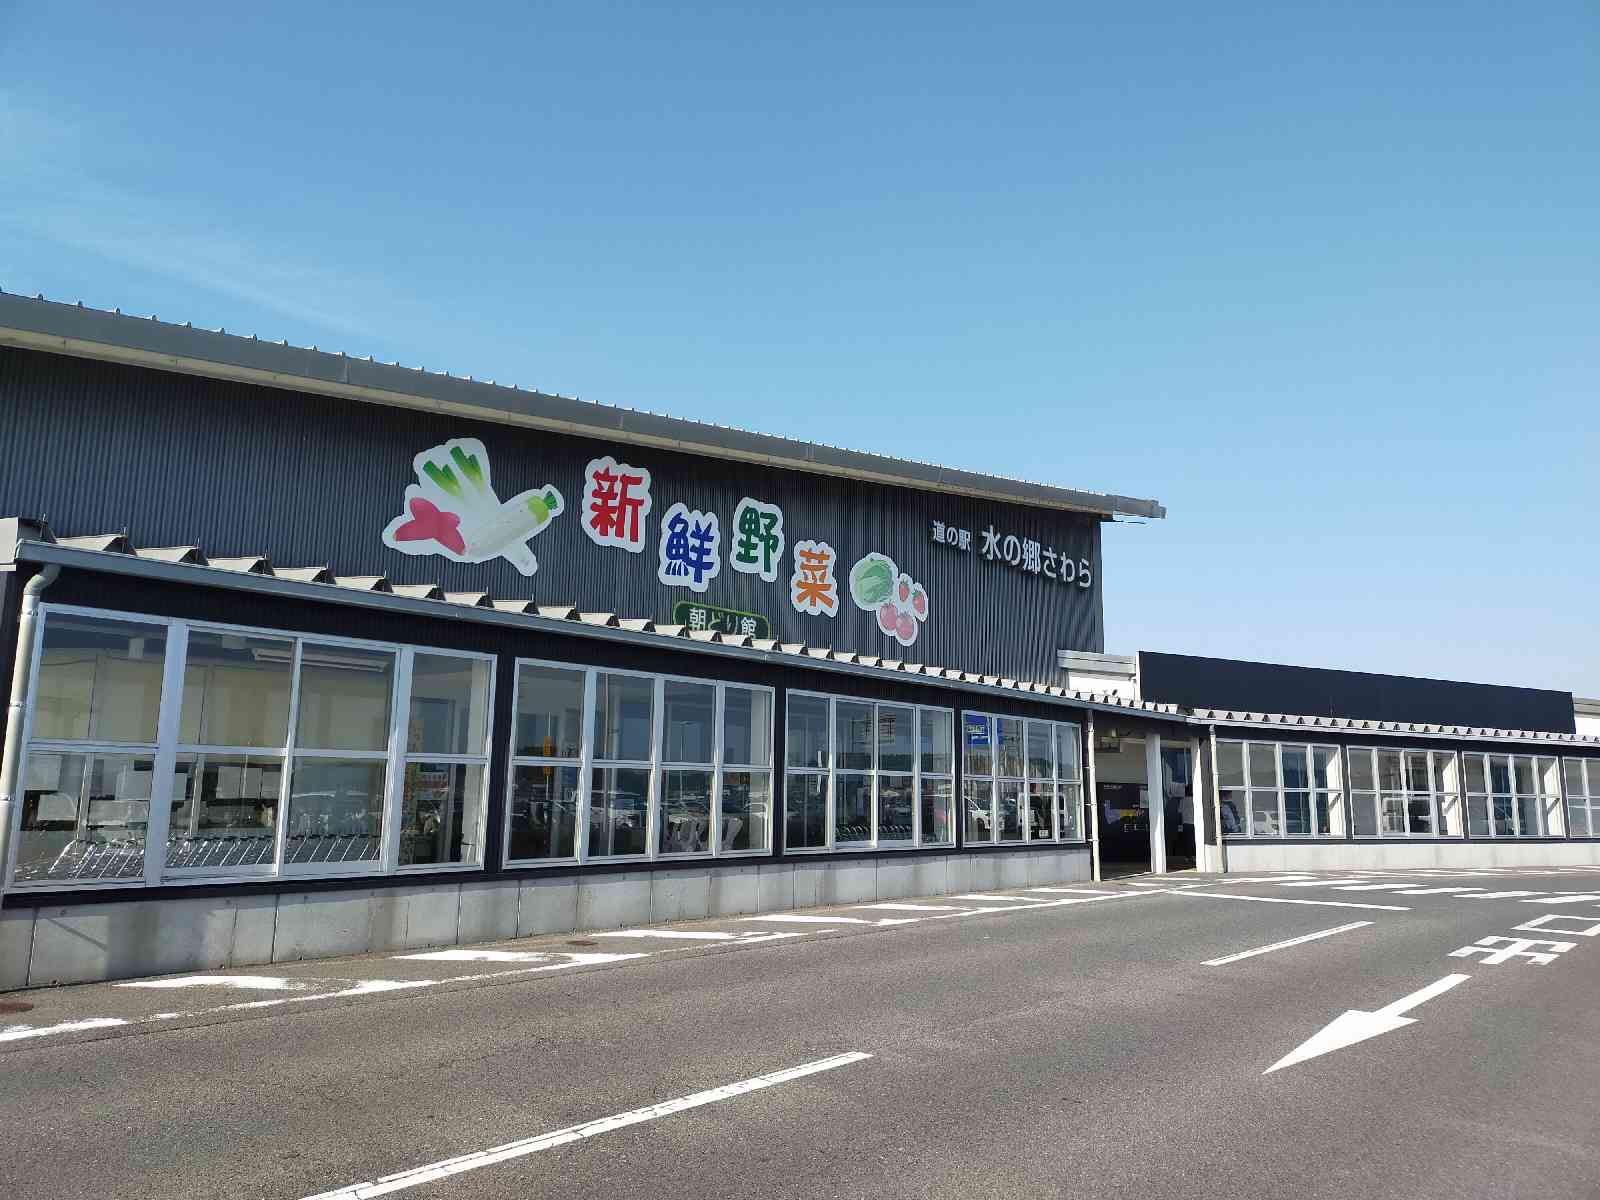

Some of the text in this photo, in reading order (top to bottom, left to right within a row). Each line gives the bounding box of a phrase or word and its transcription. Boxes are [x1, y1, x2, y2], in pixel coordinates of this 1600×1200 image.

[590, 464, 834, 609] 新鮮野菜
[933, 520, 1092, 588] 道の駅 水の郷さわら
[688, 608, 757, 639] 朝どり館
